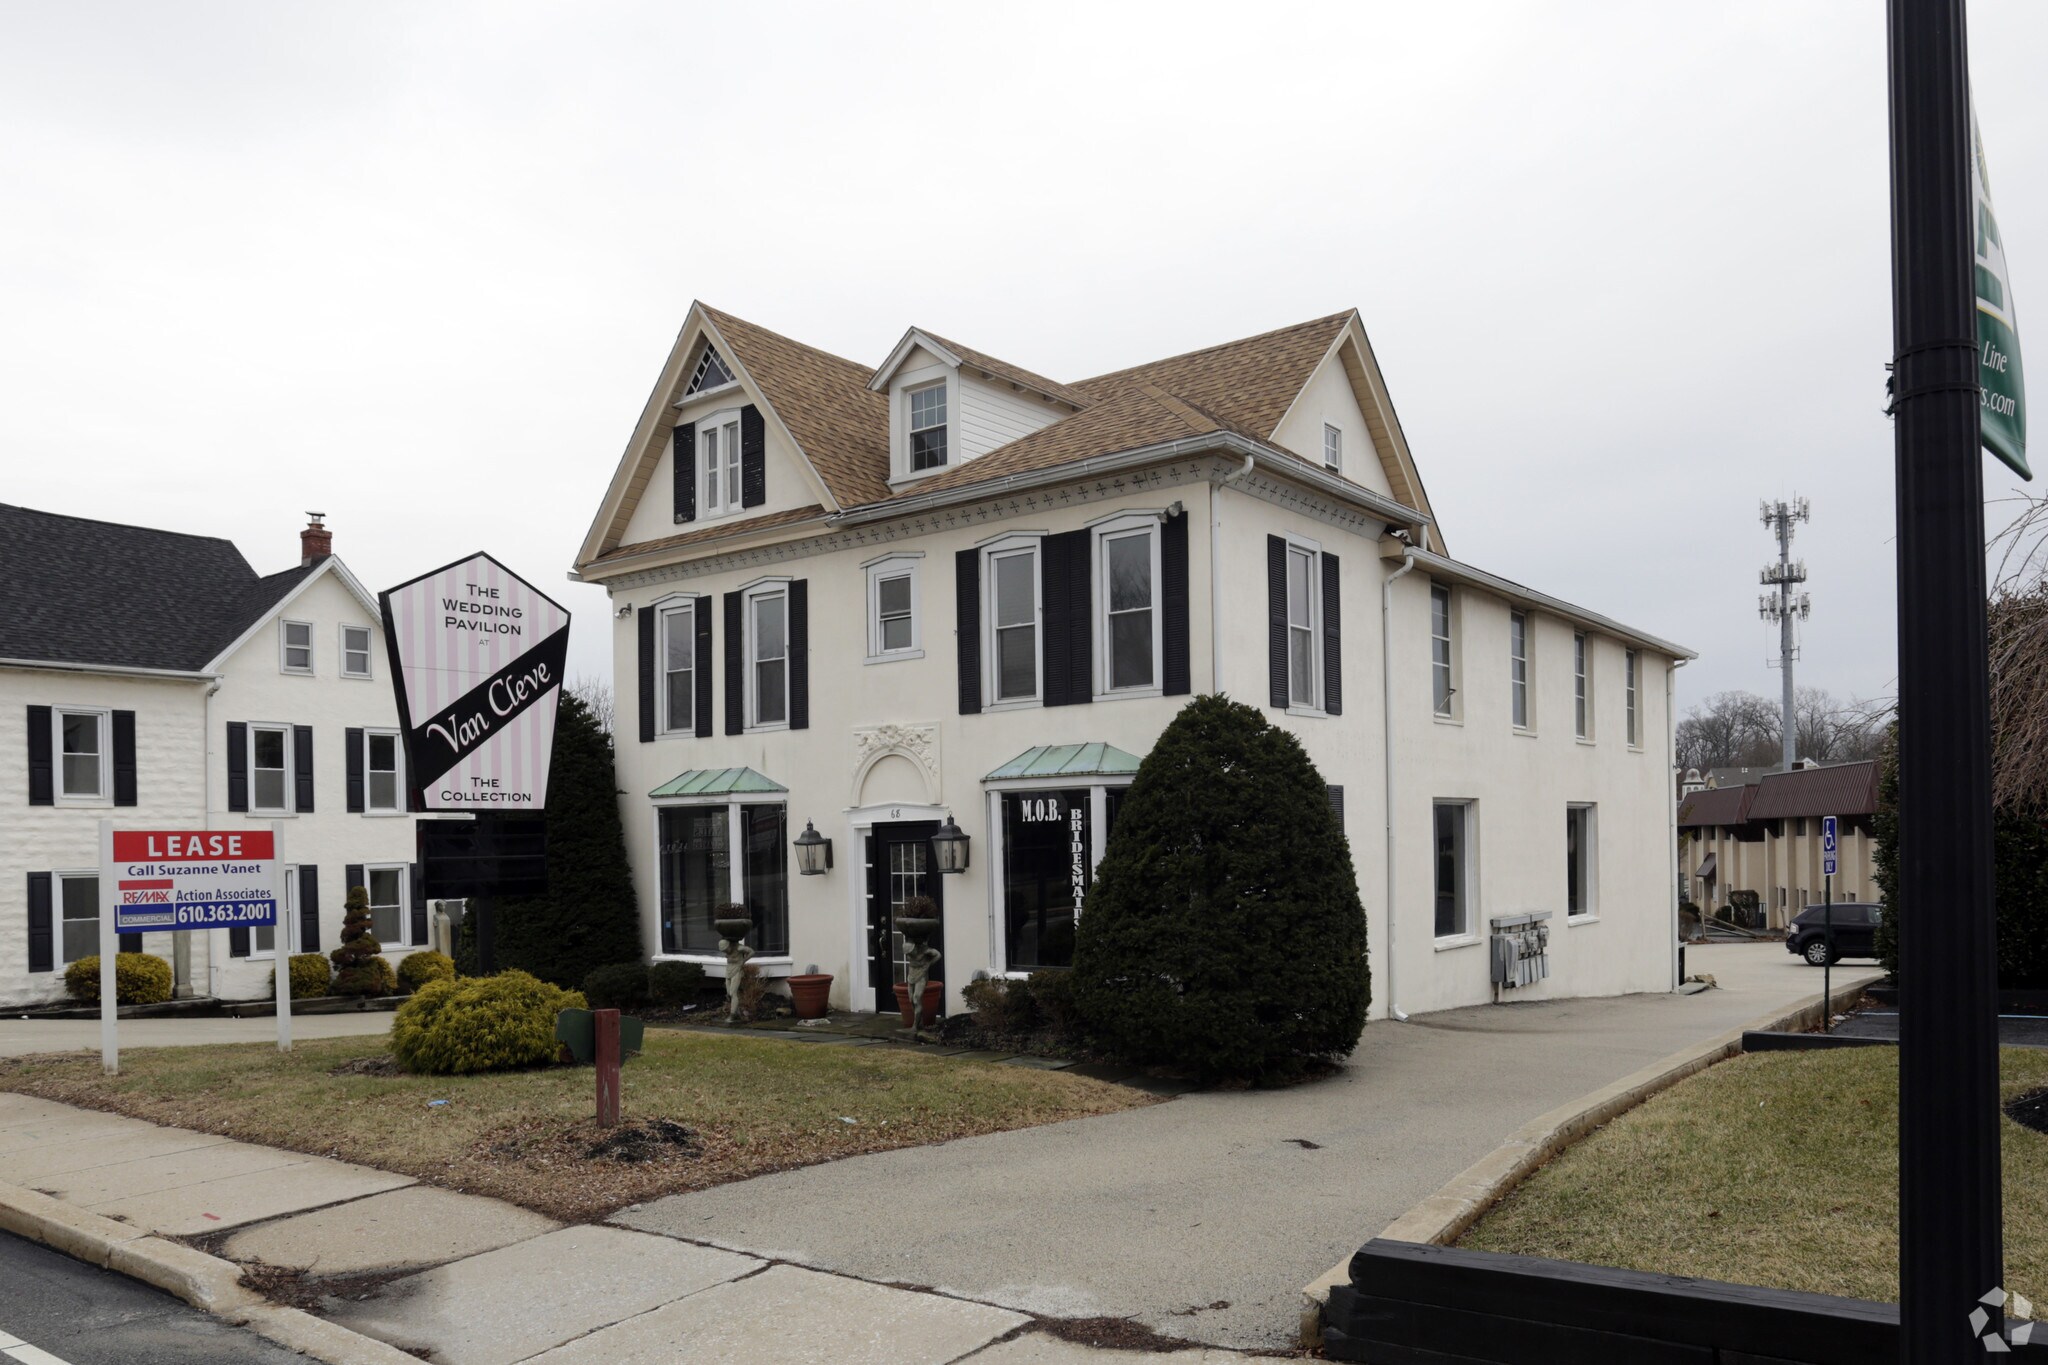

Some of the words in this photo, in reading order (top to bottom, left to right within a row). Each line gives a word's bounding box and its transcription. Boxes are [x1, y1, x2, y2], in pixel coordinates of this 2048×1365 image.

[1982, 341, 2008, 373] Line
[1980, 387, 2016, 417] s.com
[466, 583, 500, 599] THE
[442, 598, 523, 619] WEDDING
[444, 616, 522, 636] PAVILION
[478, 638, 490, 647] AT
[426, 712, 490, 754] Van
[488, 662, 551, 718] Cleve
[470, 776, 500, 788] THE
[441, 790, 532, 803] COLLECTION
[890, 808, 901, 819] 68
[1022, 798, 1062, 822] M.O.B.
[147, 835, 243, 857] LEASE
[127, 865, 154, 877] Call
[158, 864, 219, 876] Suzanne
[221, 863, 262, 874] Vanet
[123, 890, 170, 905] RE/MAX
[176, 888, 213, 901] Action
[215, 887, 272, 900] Associates
[122, 914, 173, 924] COMMERCIAL
[178, 902, 271, 924] 610.363.2001
